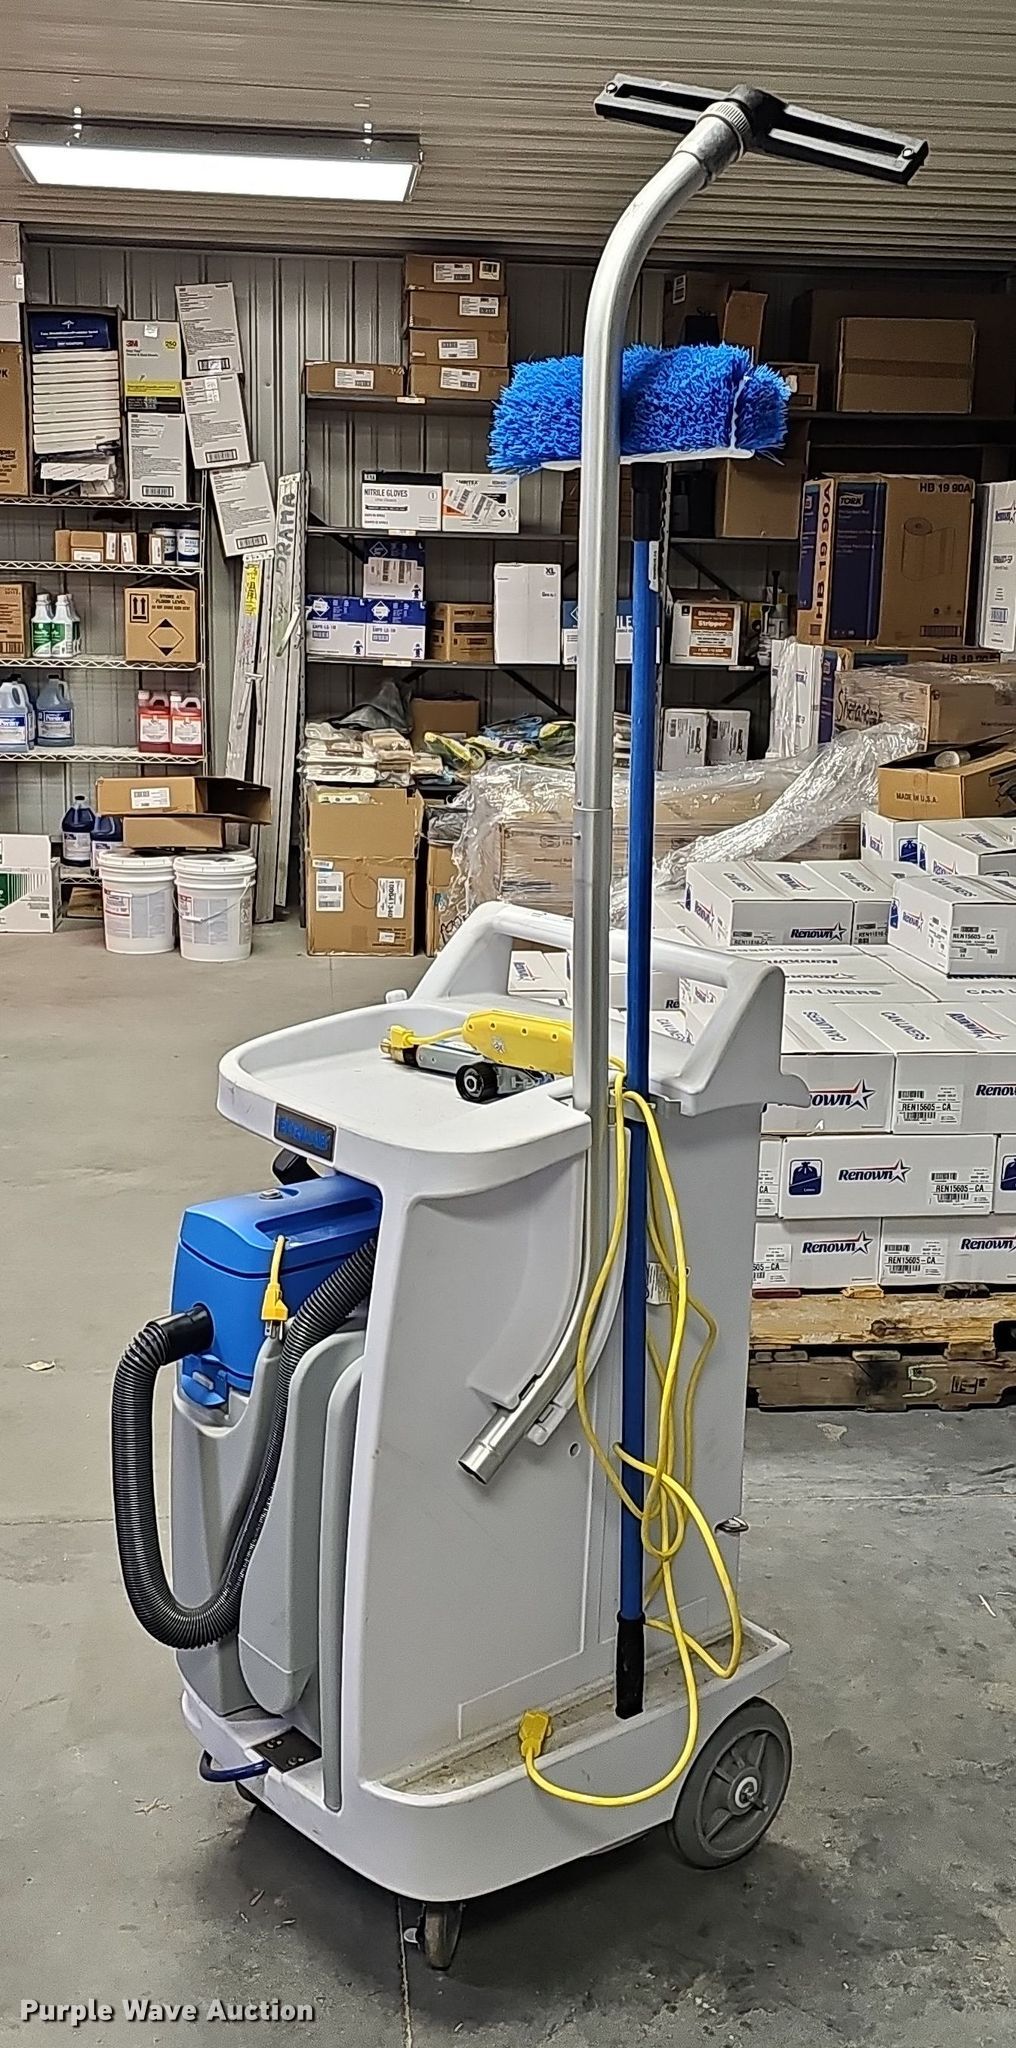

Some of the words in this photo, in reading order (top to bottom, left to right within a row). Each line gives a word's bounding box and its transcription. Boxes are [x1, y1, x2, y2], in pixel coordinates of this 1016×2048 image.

[364, 488, 385, 498] NITRILE
[386, 489, 409, 499] GLOVES
[919, 482, 935, 492] HB
[938, 483, 950, 493] 19
[951, 483, 972, 494] 90A
[840, 497, 862, 505] TORK
[545, 567, 556, 576] XL
[896, 792, 911, 801] MADE
[791, 928, 834, 939] Renown
[816, 988, 882, 996] LINERS
[838, 1168, 894, 1182] Renown
[802, 1241, 857, 1254] Renown
[960, 1237, 1014, 1250] Renown
